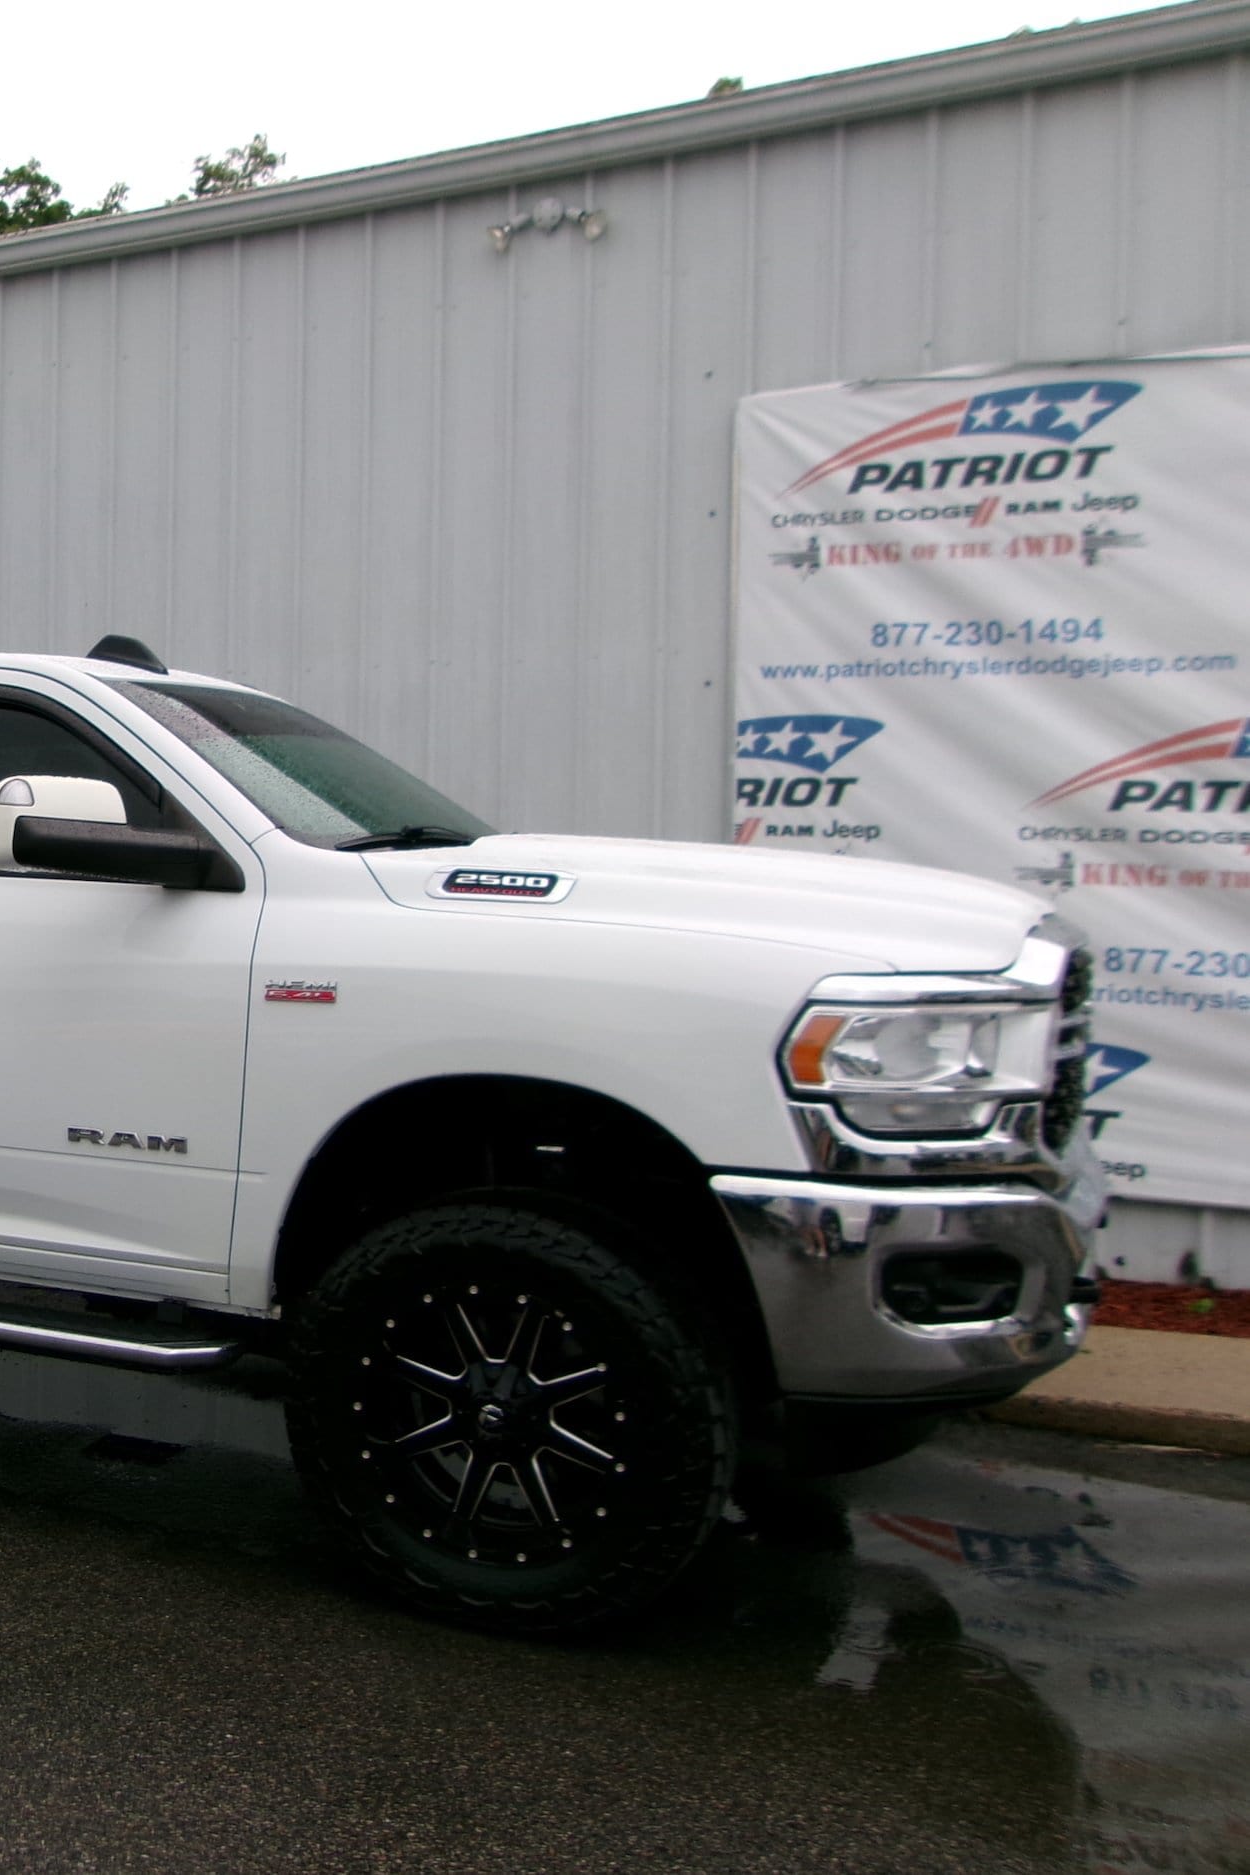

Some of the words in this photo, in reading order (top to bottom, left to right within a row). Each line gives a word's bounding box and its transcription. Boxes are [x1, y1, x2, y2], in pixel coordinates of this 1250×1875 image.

[847, 445, 1114, 494] PATRIOT
[770, 509, 865, 529] CHRYSLER
[874, 503, 979, 522] DODGE
[1005, 499, 1062, 515] RAM
[1071, 491, 1141, 514] Jeep
[827, 540, 902, 567] KING
[910, 543, 939, 561] OF
[947, 542, 993, 560] THE
[1005, 532, 1075, 560] 4WD
[870, 616, 1105, 648] 877-230-1494
[759, 653, 1237, 682] www.patriotchryslerdodgejeep.com
[735, 776, 860, 807] RIOT
[765, 824, 815, 838] RAM
[822, 818, 882, 842] Jeep
[1018, 825, 1129, 843] CHRYSLER
[455, 873, 550, 889] 2500
[1081, 863, 1169, 886] KING
[1178, 868, 1210, 886] OF
[451, 886, 501, 894] HEAVY
[1093, 983, 1250, 1012] riotchrysle
[67, 1125, 188, 1154] RAM
[1100, 1160, 1147, 1182] eep
